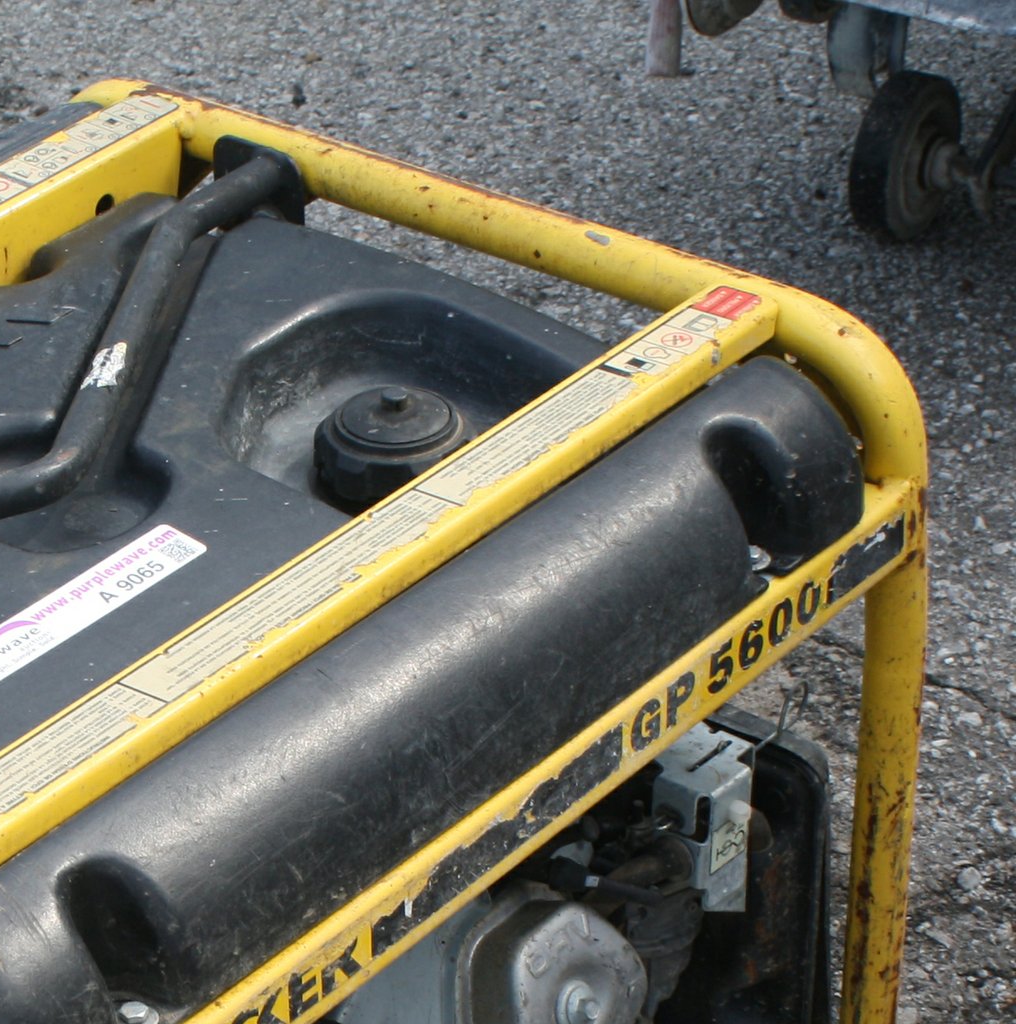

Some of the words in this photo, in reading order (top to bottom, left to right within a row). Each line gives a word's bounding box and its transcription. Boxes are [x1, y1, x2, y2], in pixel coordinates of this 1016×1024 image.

[31, 528, 177, 622] www.purplewave.com
[99, 589, 119, 604] A
[116, 560, 165, 593] 9065
[630, 671, 695, 751] GP
[706, 580, 822, 695] 5600
